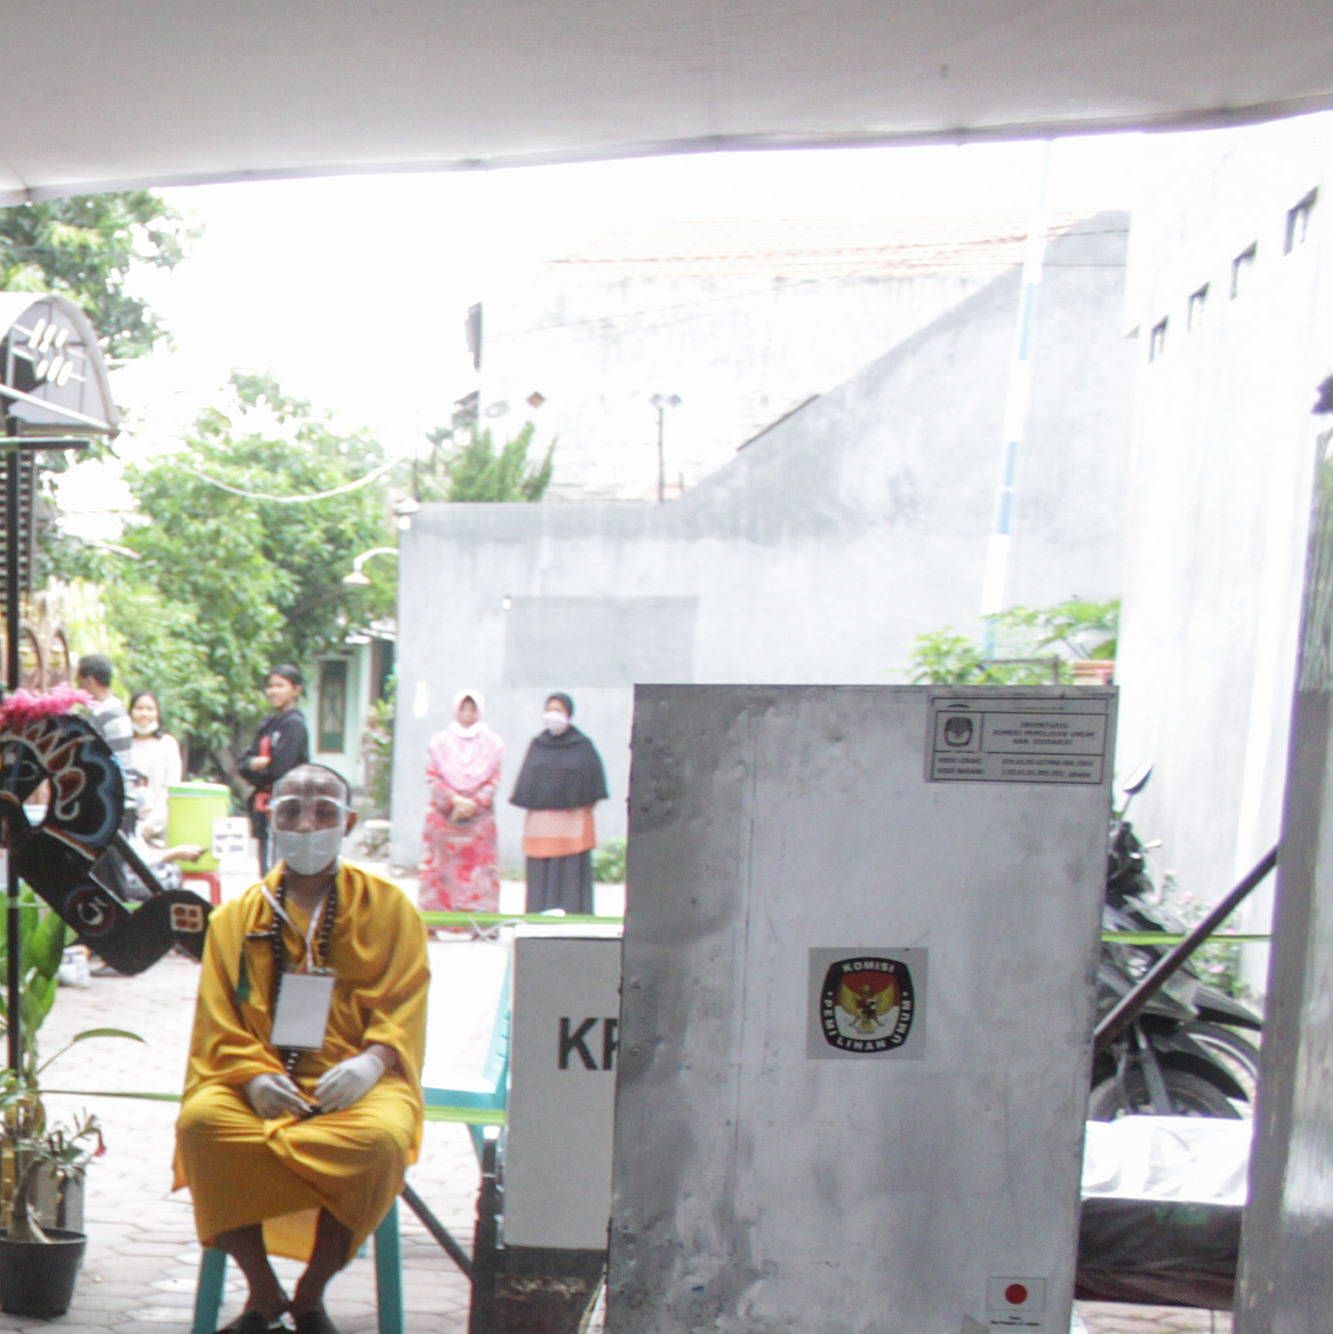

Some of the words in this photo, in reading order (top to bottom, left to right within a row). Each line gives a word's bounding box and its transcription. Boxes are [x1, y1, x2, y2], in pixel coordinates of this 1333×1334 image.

[842, 961, 896, 974] KOMISI
[823, 999, 886, 1051] PEMILIHAN
[891, 1001, 912, 1044] UMUM
